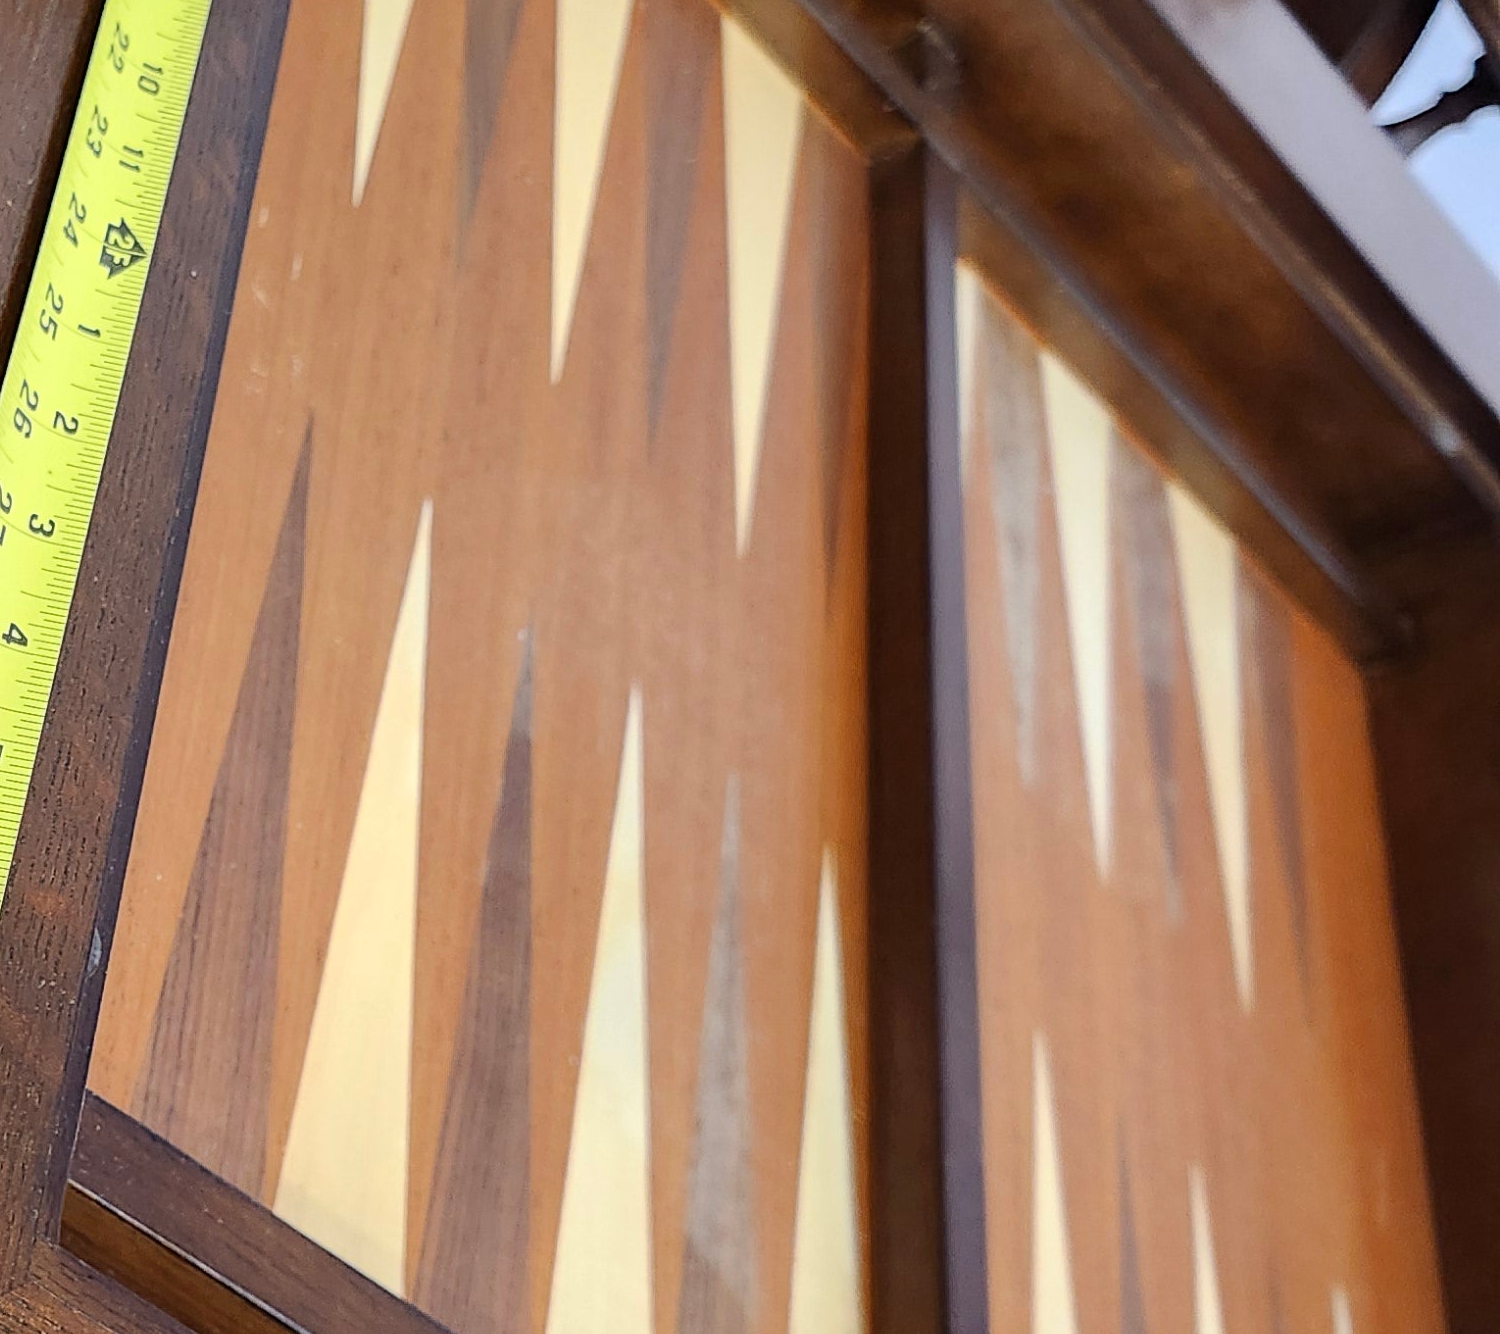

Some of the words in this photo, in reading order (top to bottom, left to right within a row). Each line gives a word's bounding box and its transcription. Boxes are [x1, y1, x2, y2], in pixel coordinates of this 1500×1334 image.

[106, 22, 130, 75] 22
[137, 62, 163, 97] 10
[85, 104, 109, 159] 23
[118, 145, 145, 174] 11
[62, 192, 87, 248] 24
[104, 224, 137, 267] 2F
[39, 282, 64, 341] 25
[78, 323, 102, 339] 1
[13, 378, 40, 439] 26
[52, 411, 79, 435] 2
[28, 514, 56, 538] 3
[1, 622, 29, 647] 4
